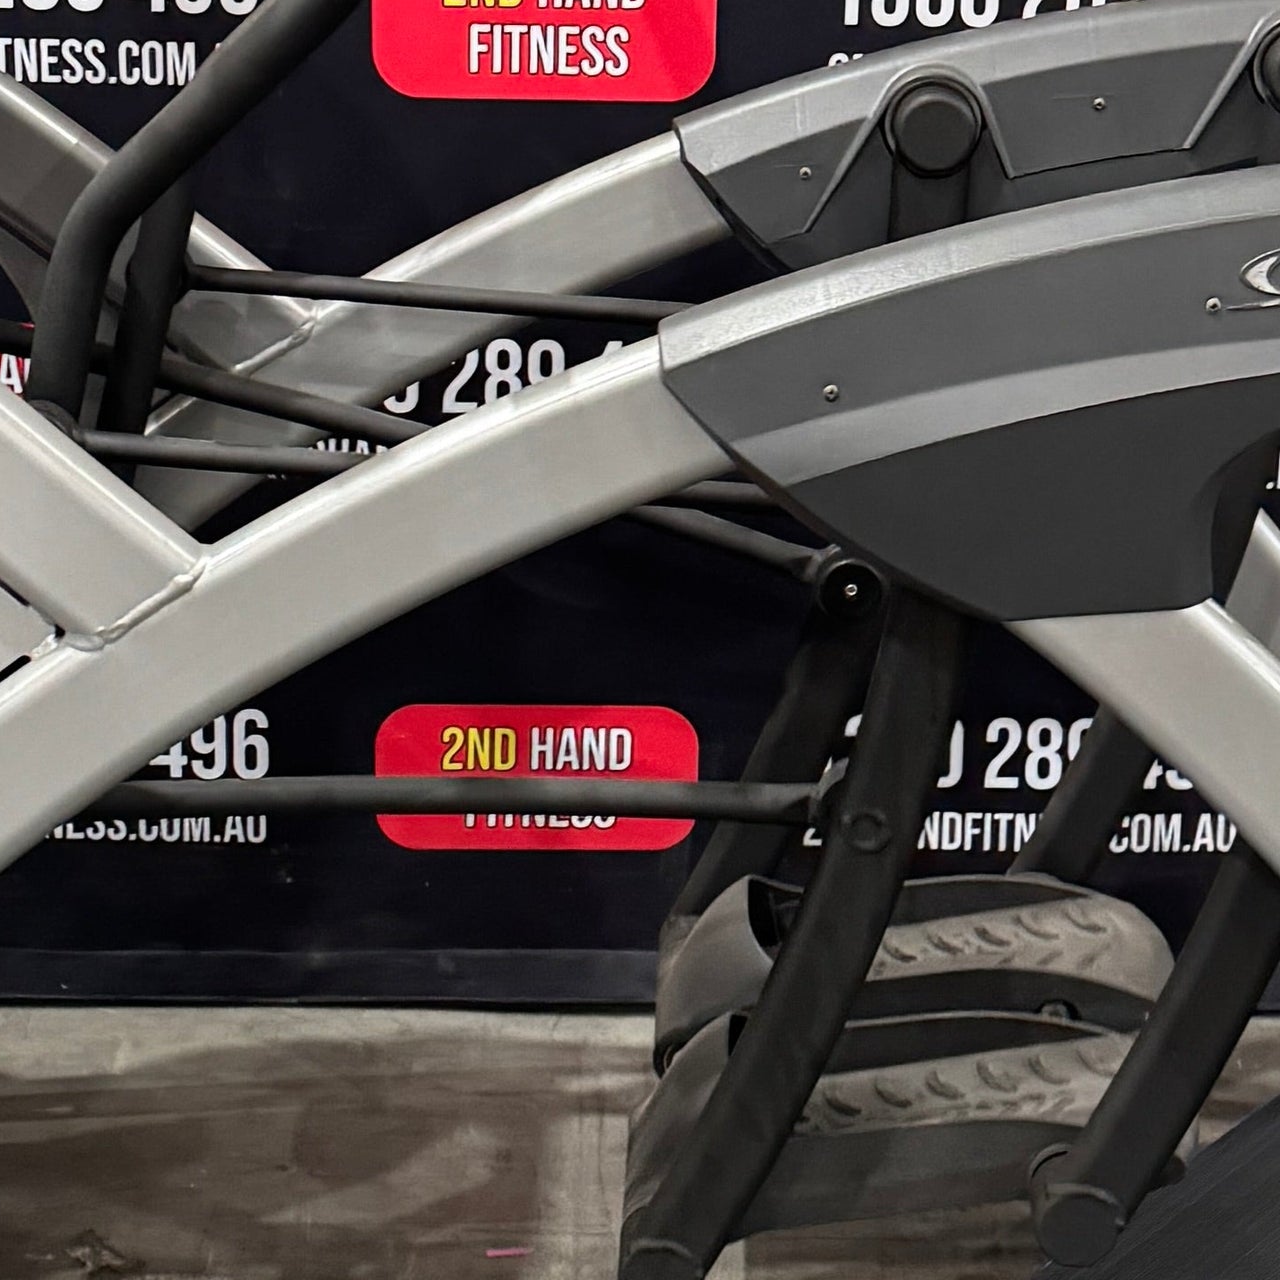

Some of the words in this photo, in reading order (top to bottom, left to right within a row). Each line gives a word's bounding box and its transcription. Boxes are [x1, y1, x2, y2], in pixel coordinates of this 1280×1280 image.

[469, 23, 629, 76] FITNESS
[442, 726, 517, 770] 2ND
[529, 726, 633, 770] HAND
